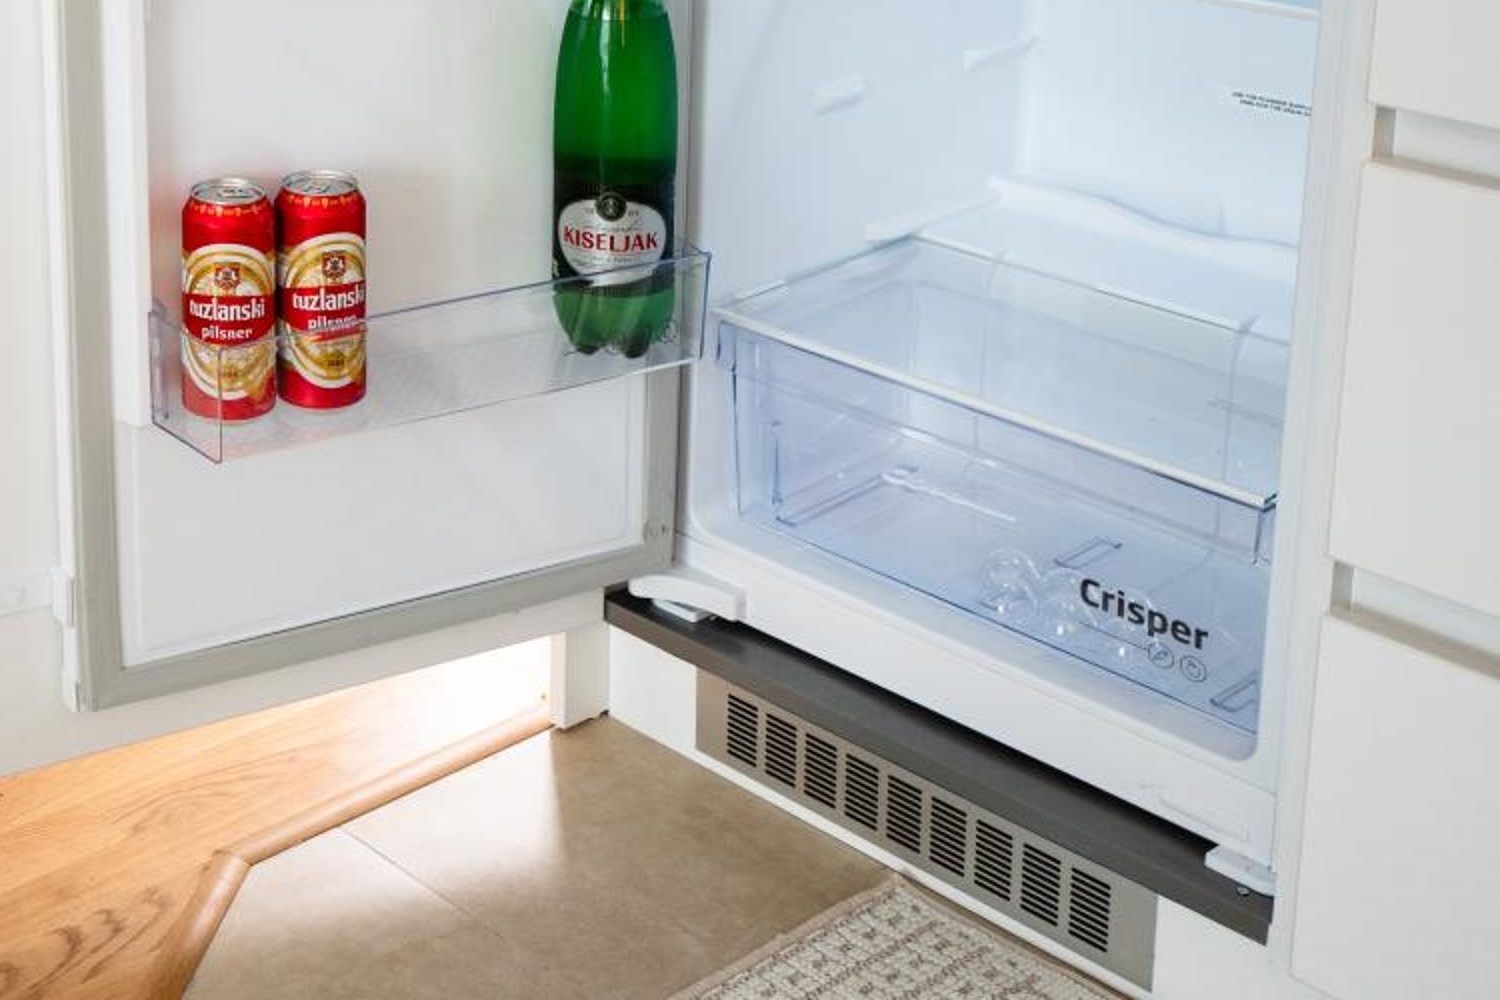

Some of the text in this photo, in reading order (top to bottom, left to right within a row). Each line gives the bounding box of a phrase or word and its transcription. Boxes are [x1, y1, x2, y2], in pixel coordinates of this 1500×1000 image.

[563, 226, 659, 252] KISELJAK
[189, 297, 265, 320] tuzlanski
[201, 325, 253, 341] pilsner
[1079, 578, 1209, 650] Crisper
